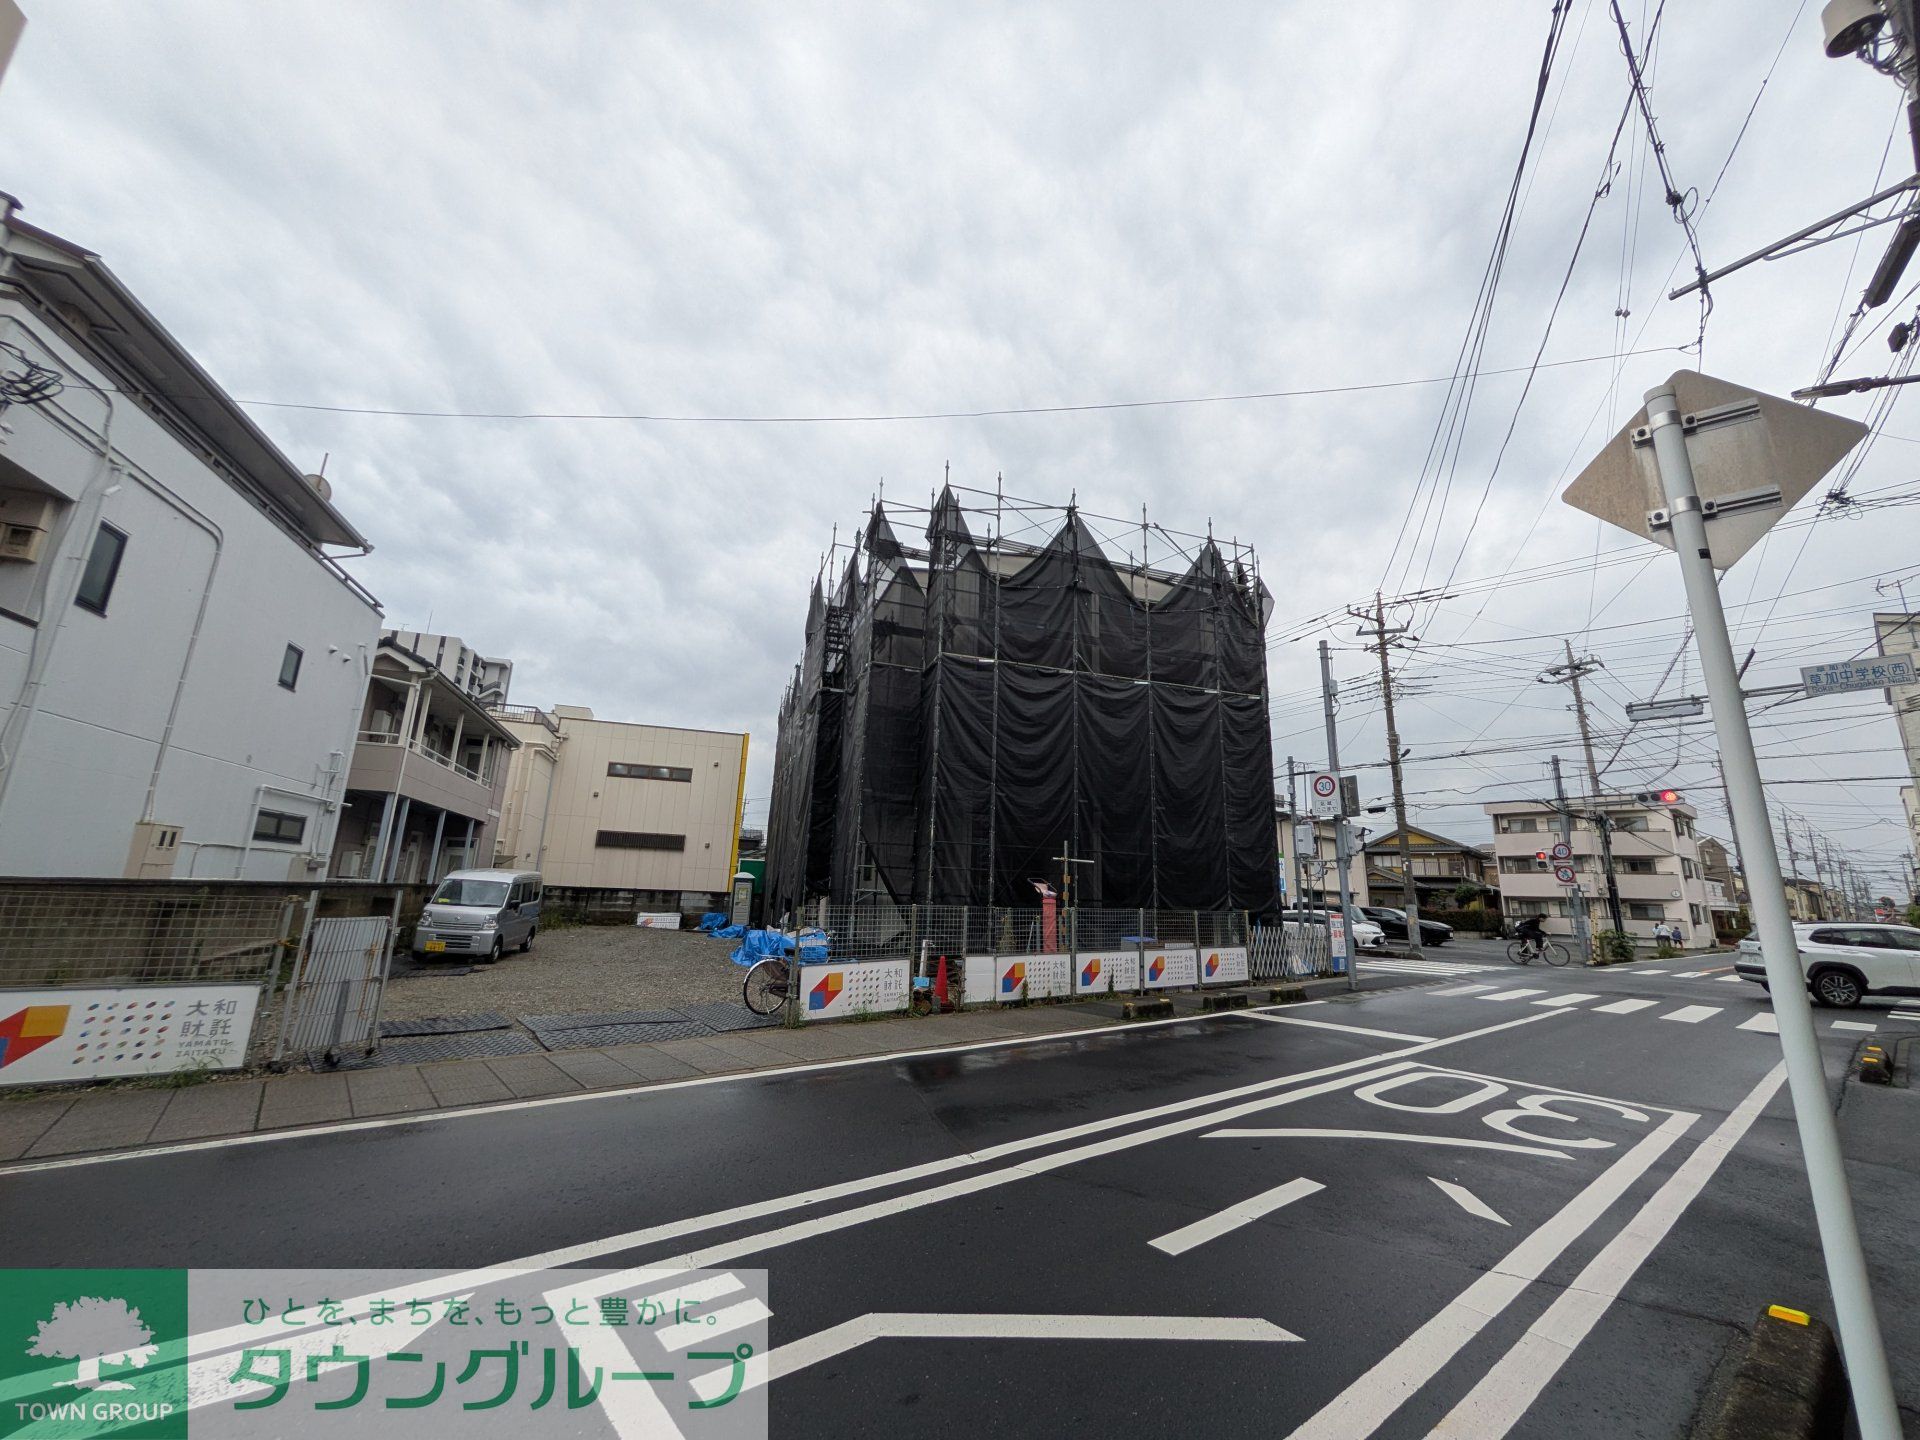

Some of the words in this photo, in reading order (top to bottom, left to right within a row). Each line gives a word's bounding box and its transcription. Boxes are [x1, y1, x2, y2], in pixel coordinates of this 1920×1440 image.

[1809, 662, 1910, 686] 草加中学校(西)
[1318, 781, 1331, 791] 30
[1557, 847, 1568, 856] 40
[884, 968, 903, 978] 大和
[186, 999, 238, 1016] 大和
[180, 1019, 232, 1038] 財託
[179, 1039, 230, 1048] YAMATO
[175, 1048, 227, 1058] ZAITAKU
[1353, 1071, 1650, 1149] 30
